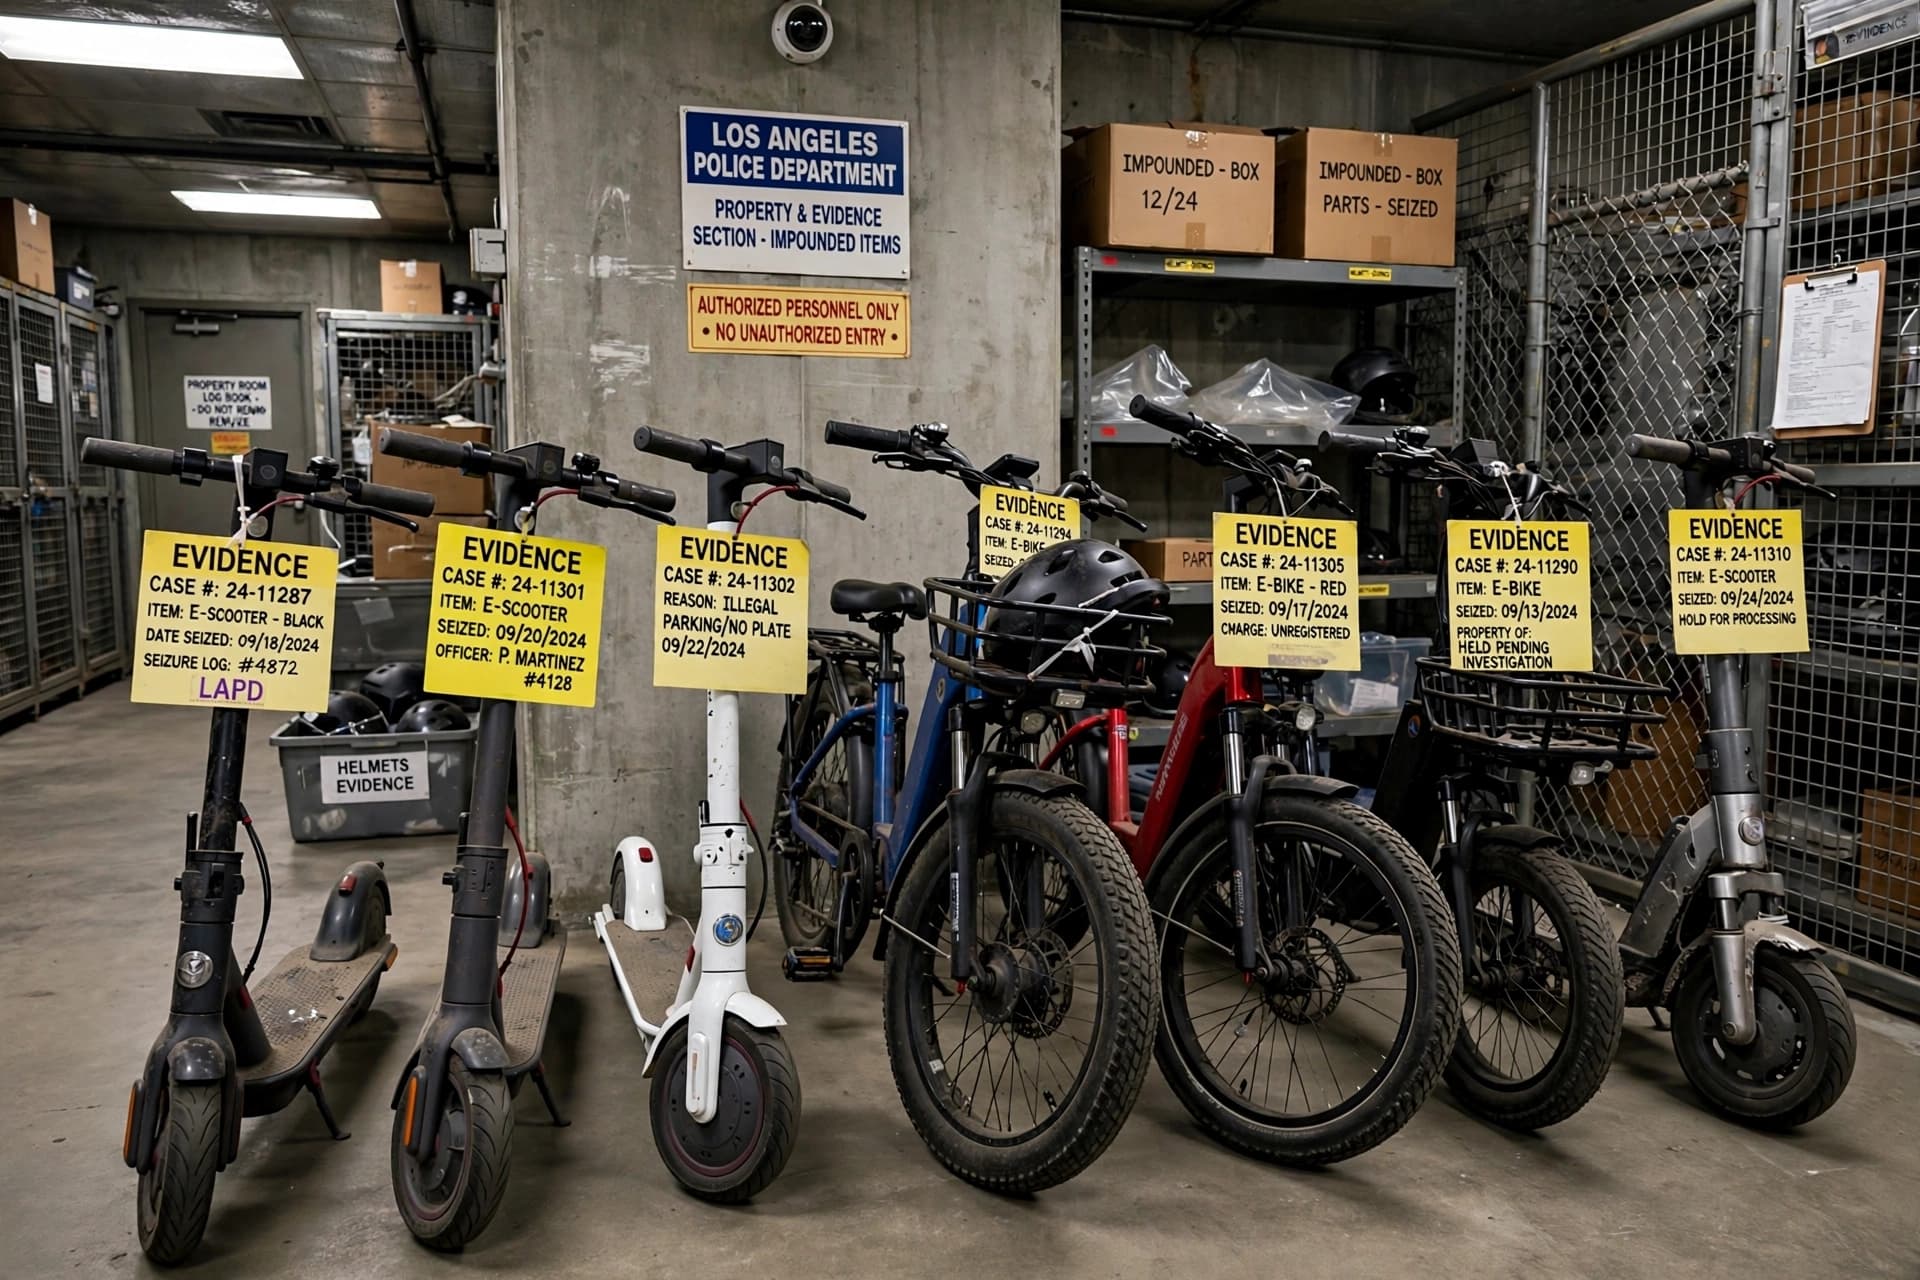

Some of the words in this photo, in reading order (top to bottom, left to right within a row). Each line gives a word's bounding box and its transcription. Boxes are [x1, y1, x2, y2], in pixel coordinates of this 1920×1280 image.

[712, 122, 760, 148] LOS
[768, 126, 878, 157] ANGELES
[694, 152, 764, 179] POLICE
[771, 157, 897, 187] DEPARTMENT
[1123, 154, 1214, 177] IMPOUNDED
[1231, 162, 1259, 181] BOX
[1320, 161, 1401, 183] IMPOUNDED
[1416, 168, 1443, 186] BOX
[1142, 186, 1198, 215] 12/24
[1324, 195, 1369, 214] PARTS
[1388, 198, 1438, 218] SEIZED
[715, 199, 792, 222] PROPERTY
[797, 204, 807, 222] &
[812, 205, 882, 226] EVIDENCE
[693, 226, 756, 247] SECTION
[771, 229, 855, 252] IMPOUNDED
[860, 234, 901, 254] ITEMS
[698, 296, 782, 316] AUTHORIZED
[786, 299, 863, 319] PERSONNEL
[867, 302, 899, 320] ONLY
[716, 323, 736, 341] NO
[740, 324, 842, 344] UNAUTHORIZED
[846, 327, 886, 346] ENTRY
[188, 380, 235, 390] PROPERTY
[204, 392, 221, 402] LOG
[198, 405, 211, 414] DO
[215, 405, 232, 414] NOT
[996, 494, 1065, 521] EVIDENCE
[986, 516, 1011, 531] CASE
[1015, 521, 1024, 533] #:
[1027, 522, 1071, 539] 24-11294
[1236, 523, 1336, 549] EVIDENCE
[1690, 518, 1783, 539] EVIDENCE
[985, 536, 1007, 548] ITEM:
[1470, 529, 1569, 551] EVIDENCE
[173, 543, 308, 579] EVIDENCE
[464, 536, 582, 574] EVIDENCE
[681, 536, 787, 569] EVIDENCE
[1221, 552, 1257, 568] CASE
[1262, 555, 1275, 569] #:
[1280, 555, 1344, 573] 24-11305
[1677, 547, 1710, 561] CASE
[1714, 547, 1726, 561] #:
[1731, 547, 1791, 561] 24-11310
[1456, 558, 1492, 573] CASE
[1497, 559, 1508, 573] #:
[1514, 558, 1578, 574] 24-11290
[1678, 572, 1704, 583] ITEM:
[1710, 569, 1776, 583] E-SCOOTER
[150, 576, 196, 595] CASE
[202, 580, 219, 597] #:
[226, 582, 311, 605] 24-11287
[443, 567, 486, 587] CASE
[492, 574, 506, 590] #:
[512, 576, 584, 600] 24-11301
[664, 566, 703, 585] CASE
[708, 571, 722, 586] #:
[728, 572, 795, 593] 24-11302
[1221, 577, 1251, 591] ITEM:
[1257, 576, 1304, 594] E-BIKE
[1320, 581, 1346, 596] RED
[1456, 582, 1486, 595] ITEM:
[1493, 580, 1541, 596] E-BIKE
[440, 594, 476, 611] ITEM:
[483, 597, 568, 623] E-SCOOTER
[664, 592, 716, 609] REASON:
[723, 596, 778, 615] ILLEGAL
[1678, 593, 1716, 605] SEIZED:
[1721, 588, 1794, 608] 09/24/2024
[148, 602, 183, 619] ITEM:
[190, 604, 267, 625] E-SCOOTER
[284, 613, 324, 630] BLACK
[1221, 600, 1264, 614] SEIZED:
[1269, 599, 1348, 621] 09/17/2024
[1456, 605, 1497, 618] SEIZED:
[1502, 601, 1577, 622] 09/13/2024
[1680, 614, 1706, 626] HOLD
[1710, 613, 1730, 625] FOR
[1733, 612, 1796, 624] PROCESSING
[438, 619, 490, 638] SEIZED:
[496, 624, 586, 648] 09/20/2024
[664, 614, 747, 637] PARKING/NO
[752, 621, 791, 638] PLATE
[1221, 623, 1267, 637] CHARGE:
[1271, 624, 1350, 639] UNREGISTERED
[1457, 627, 1511, 638] PROPERTY
[1515, 627, 1531, 638] OF:
[146, 628, 179, 643] DATE
[184, 630, 232, 647] SEIZED:
[238, 633, 319, 653] 09/18/2024
[662, 635, 745, 659] 09/22/2024
[1458, 641, 1490, 654] HELD
[1496, 641, 1549, 654] PENDING
[144, 653, 198, 669] SEIZURE
[202, 657, 230, 671] LOG:
[238, 657, 298, 675] #4872
[435, 644, 492, 662] OFFICER:
[499, 647, 510, 664] P.
[516, 649, 585, 672] MARTINEZ
[1463, 656, 1552, 669] INVESTIGATION
[199, 677, 264, 701] LAPD
[524, 672, 572, 691] #4128
[338, 759, 408, 774] HELMETS
[337, 776, 414, 793] EVIDENCE
